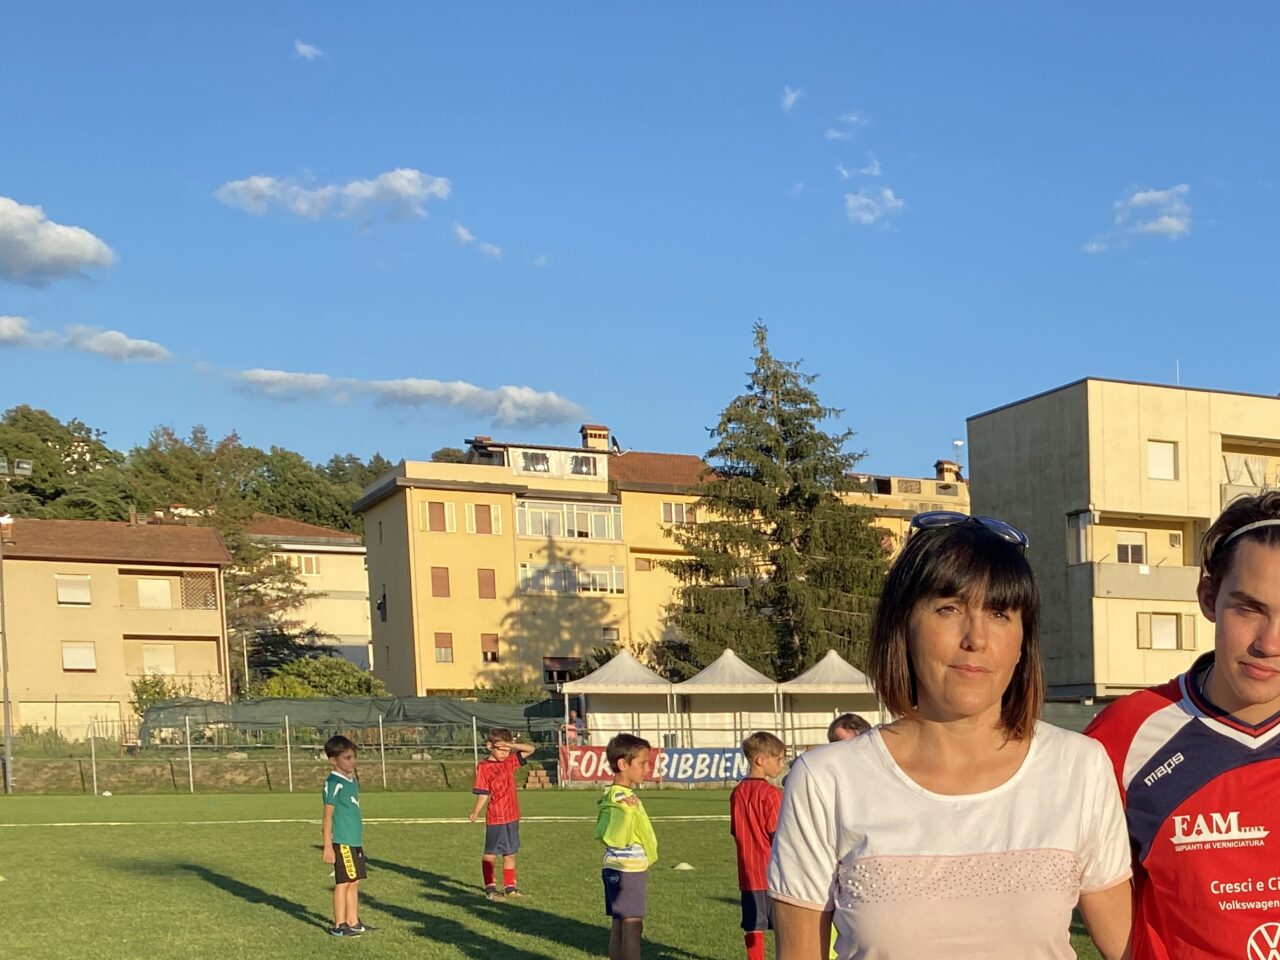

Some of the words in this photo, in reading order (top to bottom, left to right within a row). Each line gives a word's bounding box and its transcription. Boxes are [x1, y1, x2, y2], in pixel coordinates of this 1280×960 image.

[651, 751, 750, 780] BIBBIEN
[1143, 751, 1185, 787] maps
[1241, 825, 1265, 834] ITALY
[1211, 839, 1266, 849] VERNICIATURA
[1210, 877, 1253, 895] Cresci
[1256, 880, 1264, 892] e
[1217, 899, 1280, 911] Volkswagen
